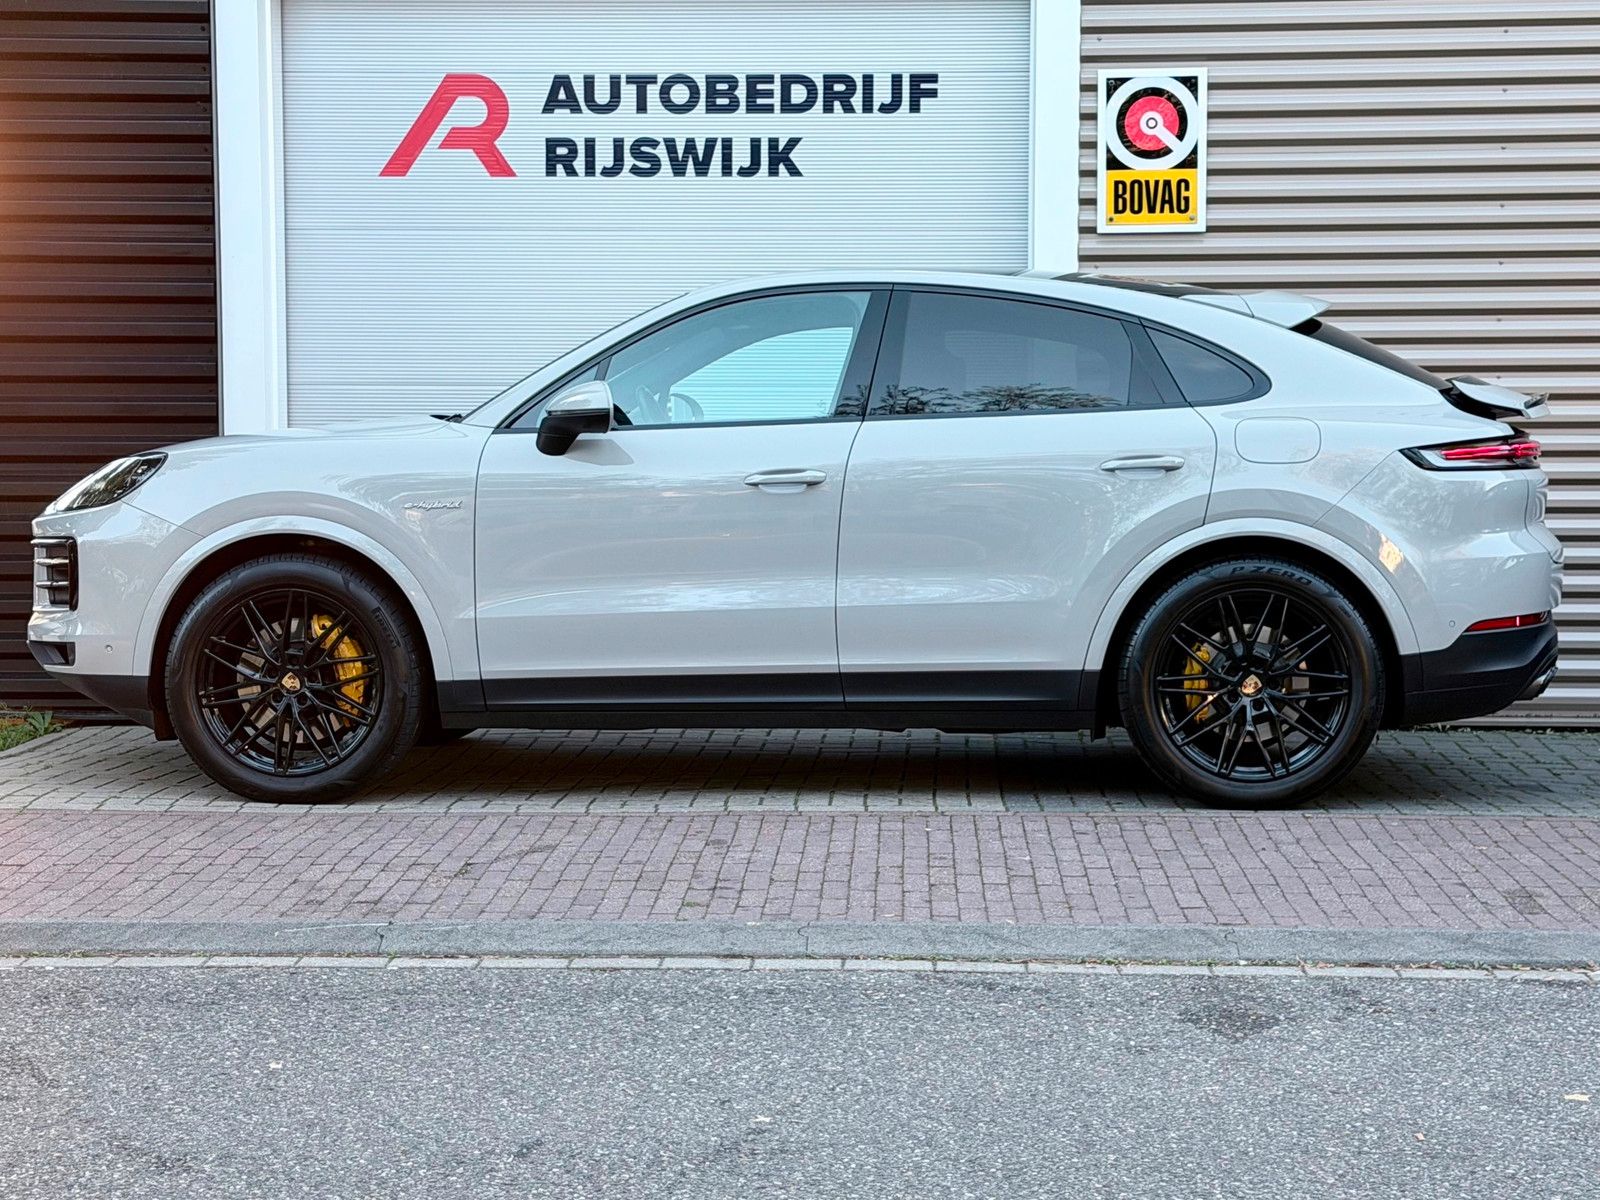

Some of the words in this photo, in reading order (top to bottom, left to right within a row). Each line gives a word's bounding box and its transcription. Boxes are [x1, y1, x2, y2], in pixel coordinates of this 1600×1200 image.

[541, 73, 939, 115] AUTOBEDRIJF
[545, 136, 804, 177] RIJSWIJK
[1113, 178, 1190, 215] BOVAG
[1250, 565, 1312, 585] ZERO
